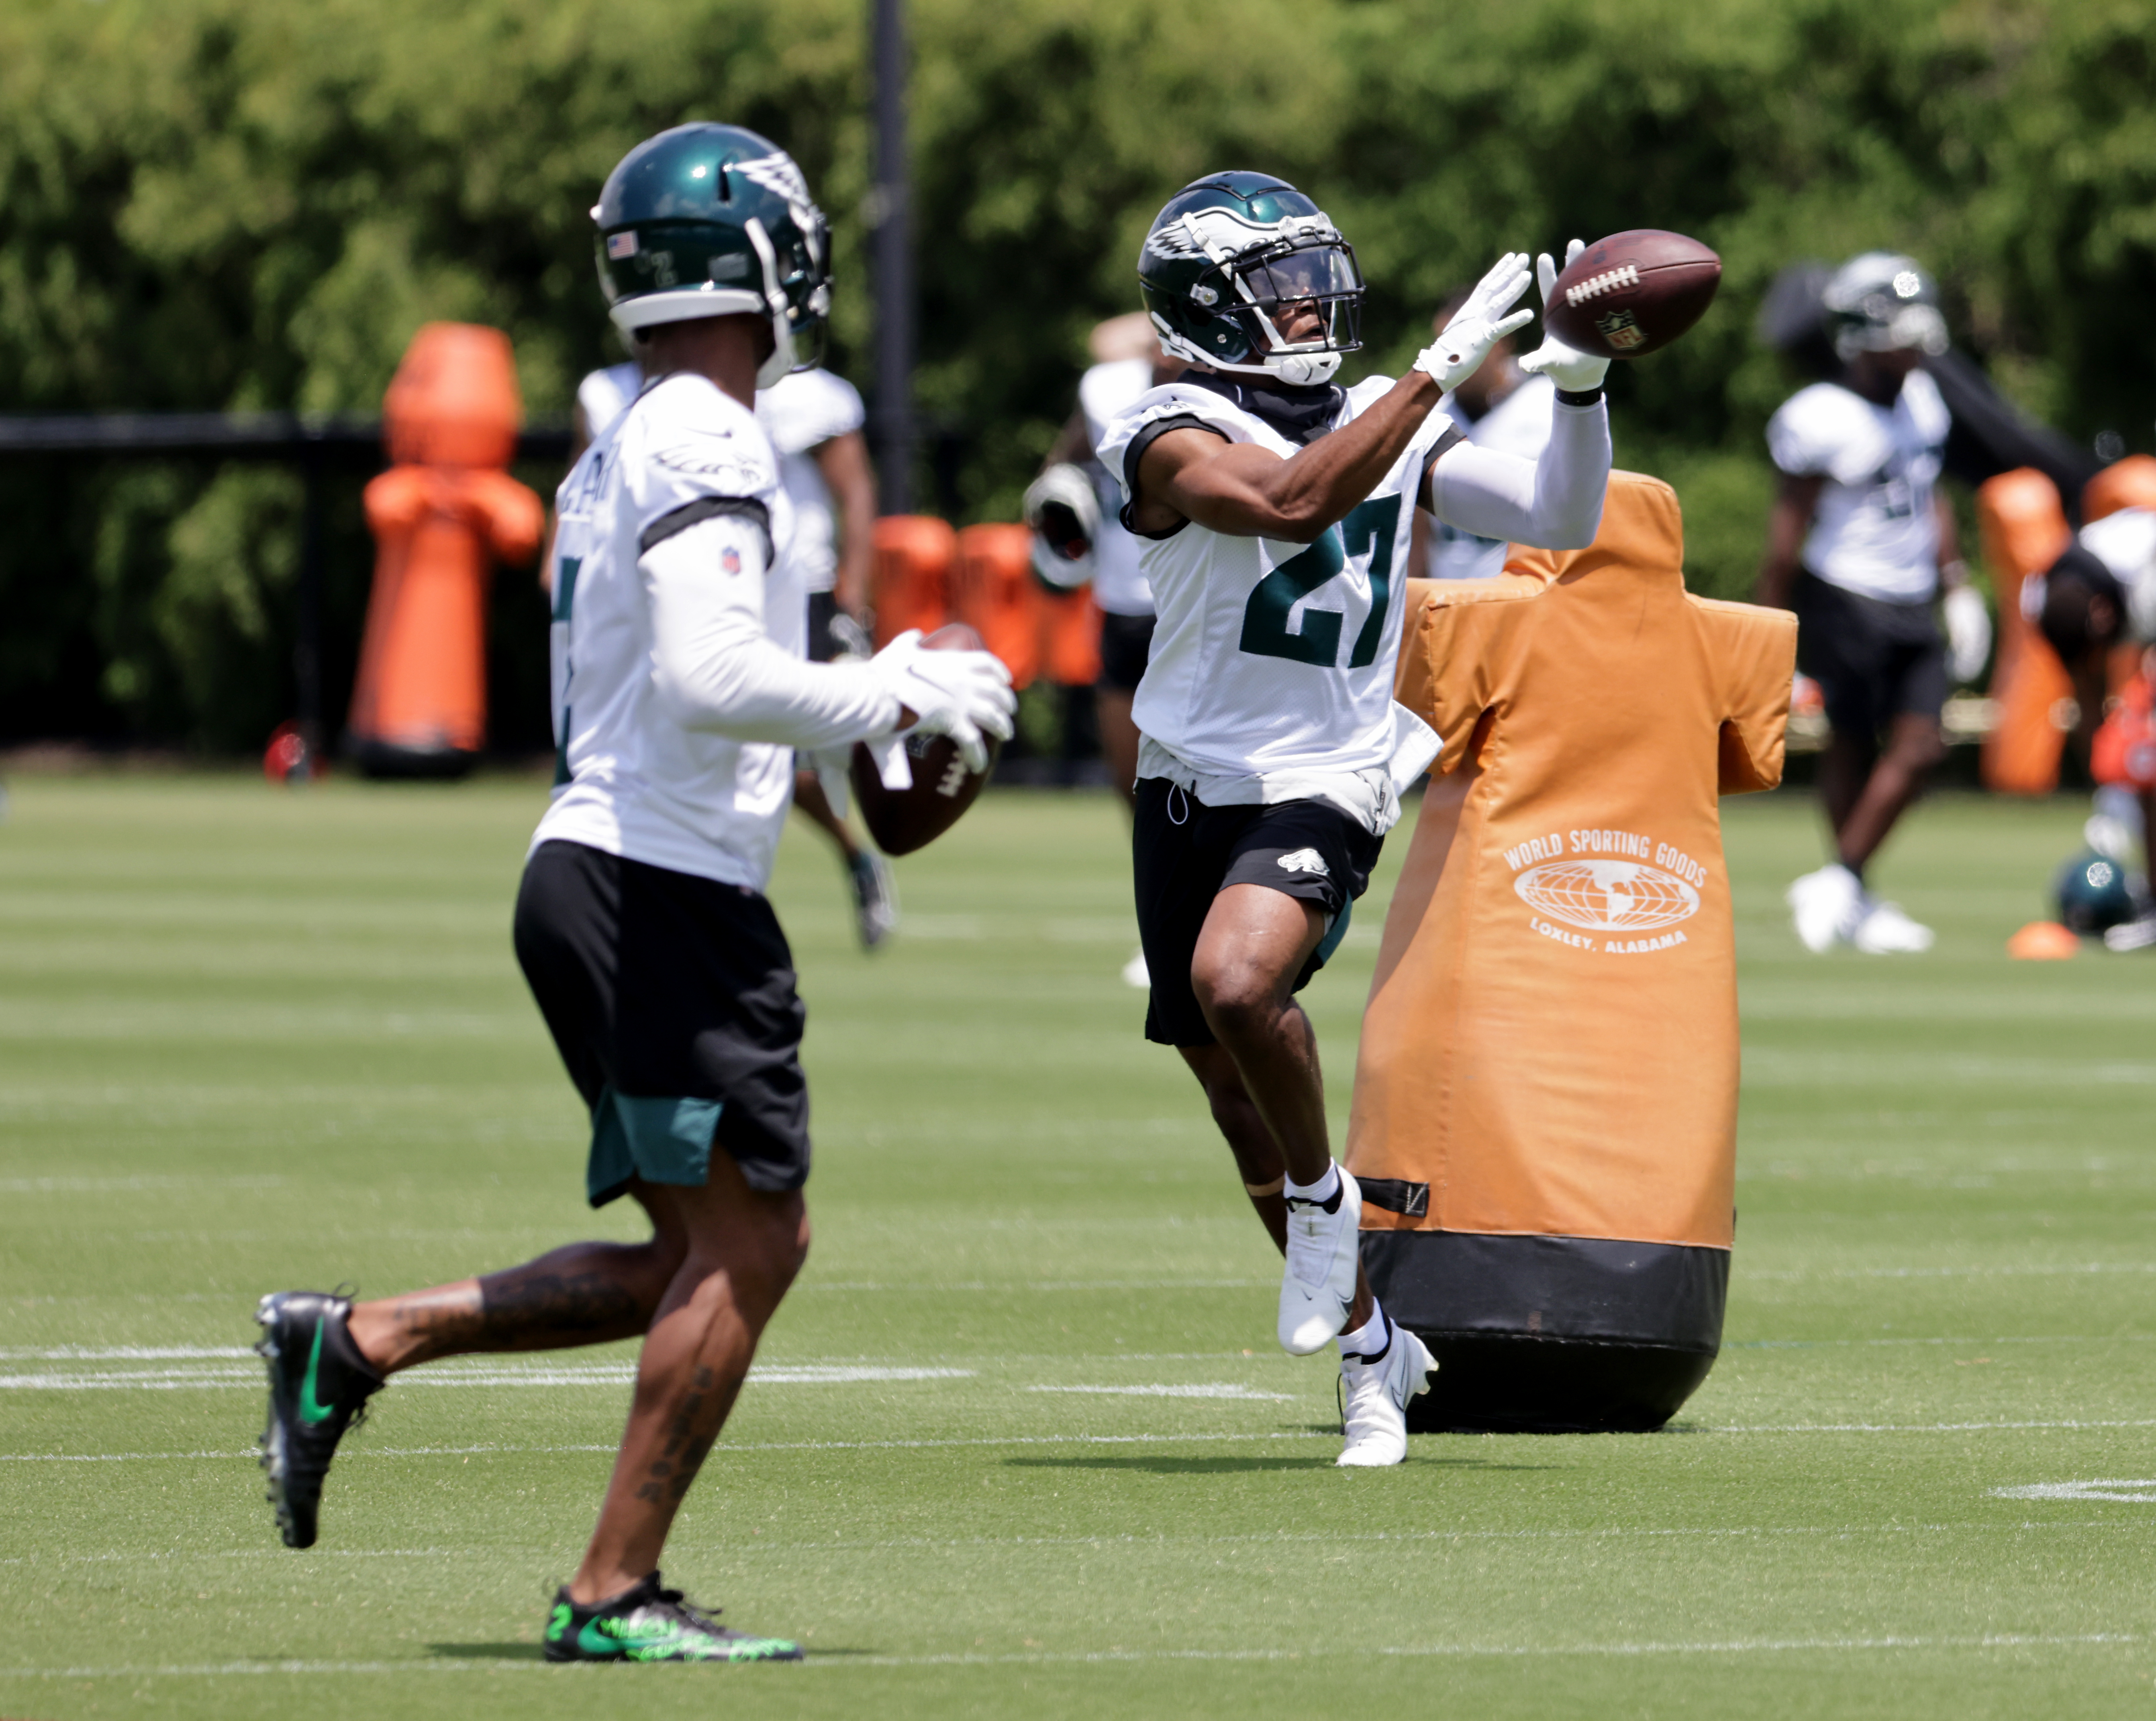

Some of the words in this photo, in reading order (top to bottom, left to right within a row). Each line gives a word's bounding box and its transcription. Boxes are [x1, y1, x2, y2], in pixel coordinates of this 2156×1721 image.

[1608, 327, 1642, 347] NFL
[1239, 491, 1402, 669] 27
[1503, 833, 1563, 871] WORLD
[1570, 829, 1651, 858] SPORTING
[1655, 842, 1707, 888] GOODS
[1529, 917, 1597, 952] LOXLEY,
[1605, 930, 1688, 954] ALABAMA
[546, 1601, 573, 1642] 2
